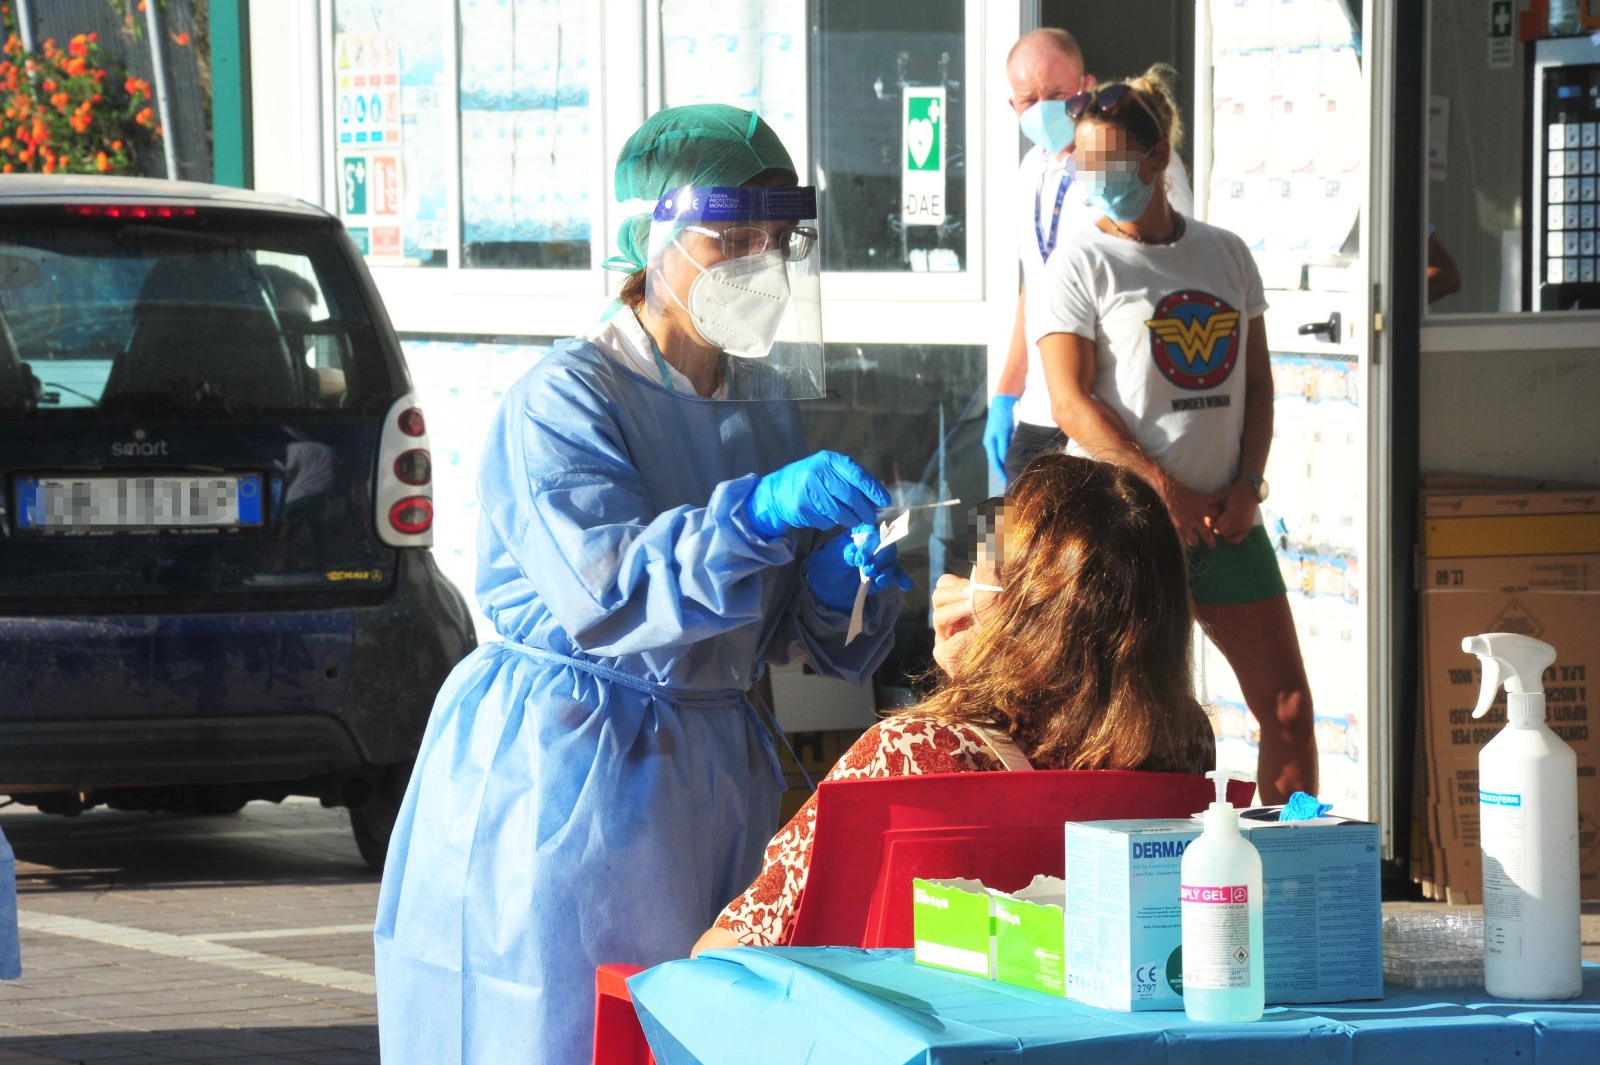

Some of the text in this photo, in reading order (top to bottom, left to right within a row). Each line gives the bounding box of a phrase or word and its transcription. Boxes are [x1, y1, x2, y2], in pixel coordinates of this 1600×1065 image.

[907, 194, 940, 216] DAE
[1171, 396, 1205, 412] WONDER
[111, 439, 169, 457] smart
[1549, 725, 1588, 741] CONTE
[1202, 889, 1227, 901] GEL
[1136, 983, 1157, 993] 2797
